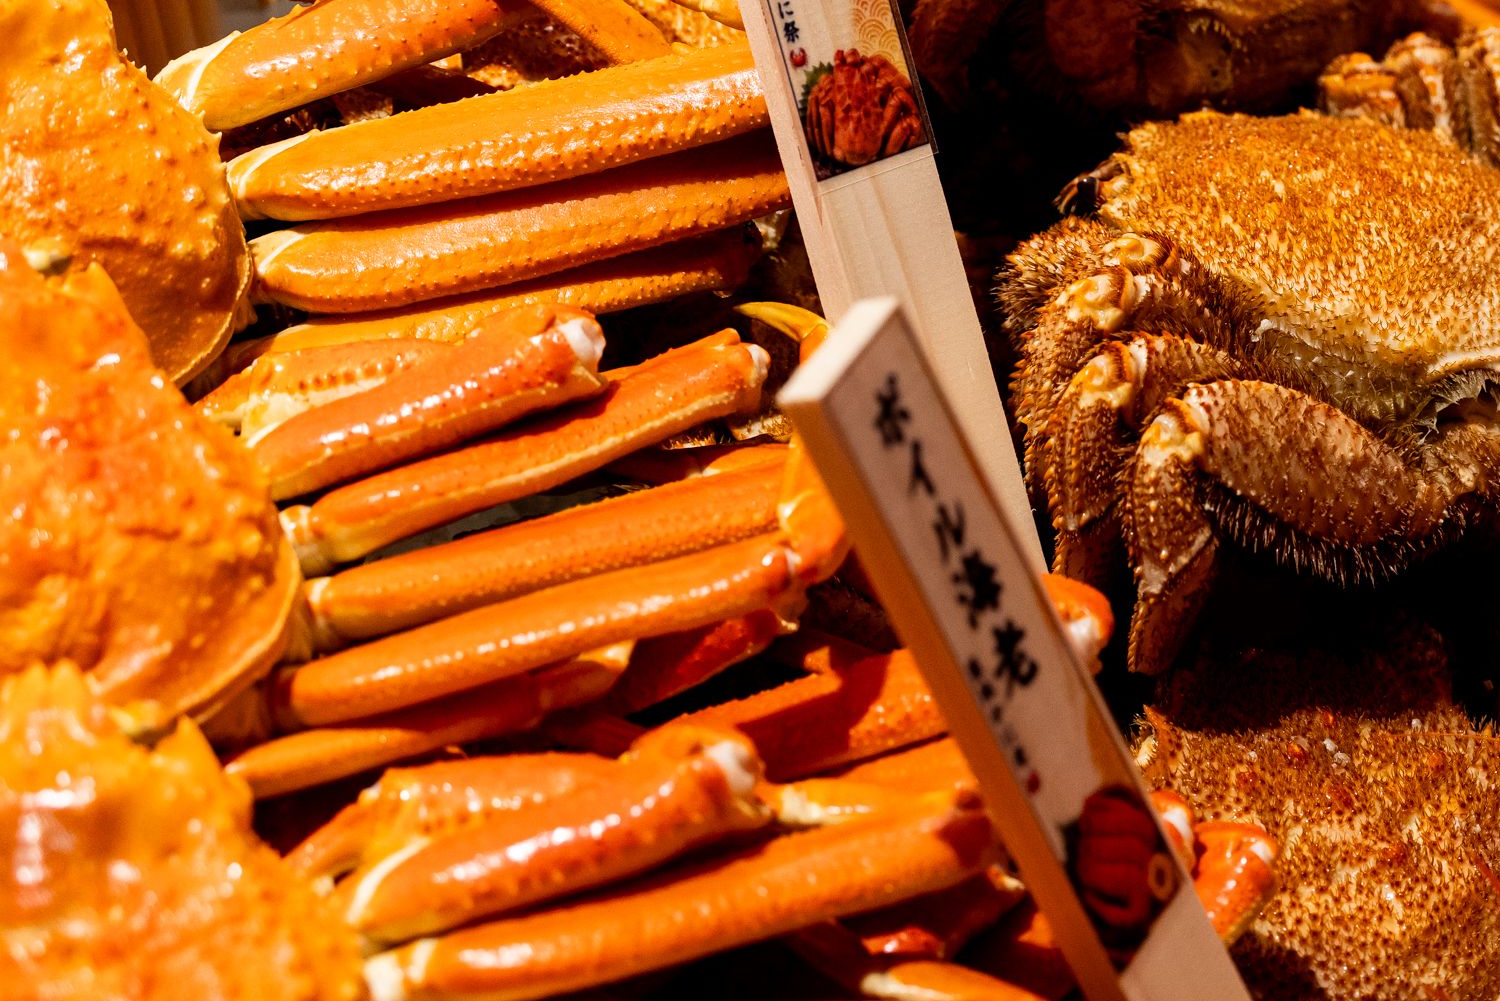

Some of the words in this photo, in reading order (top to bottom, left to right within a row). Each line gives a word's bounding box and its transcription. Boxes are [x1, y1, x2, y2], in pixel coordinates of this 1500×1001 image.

[874, 372, 1038, 697] ボイル海老
